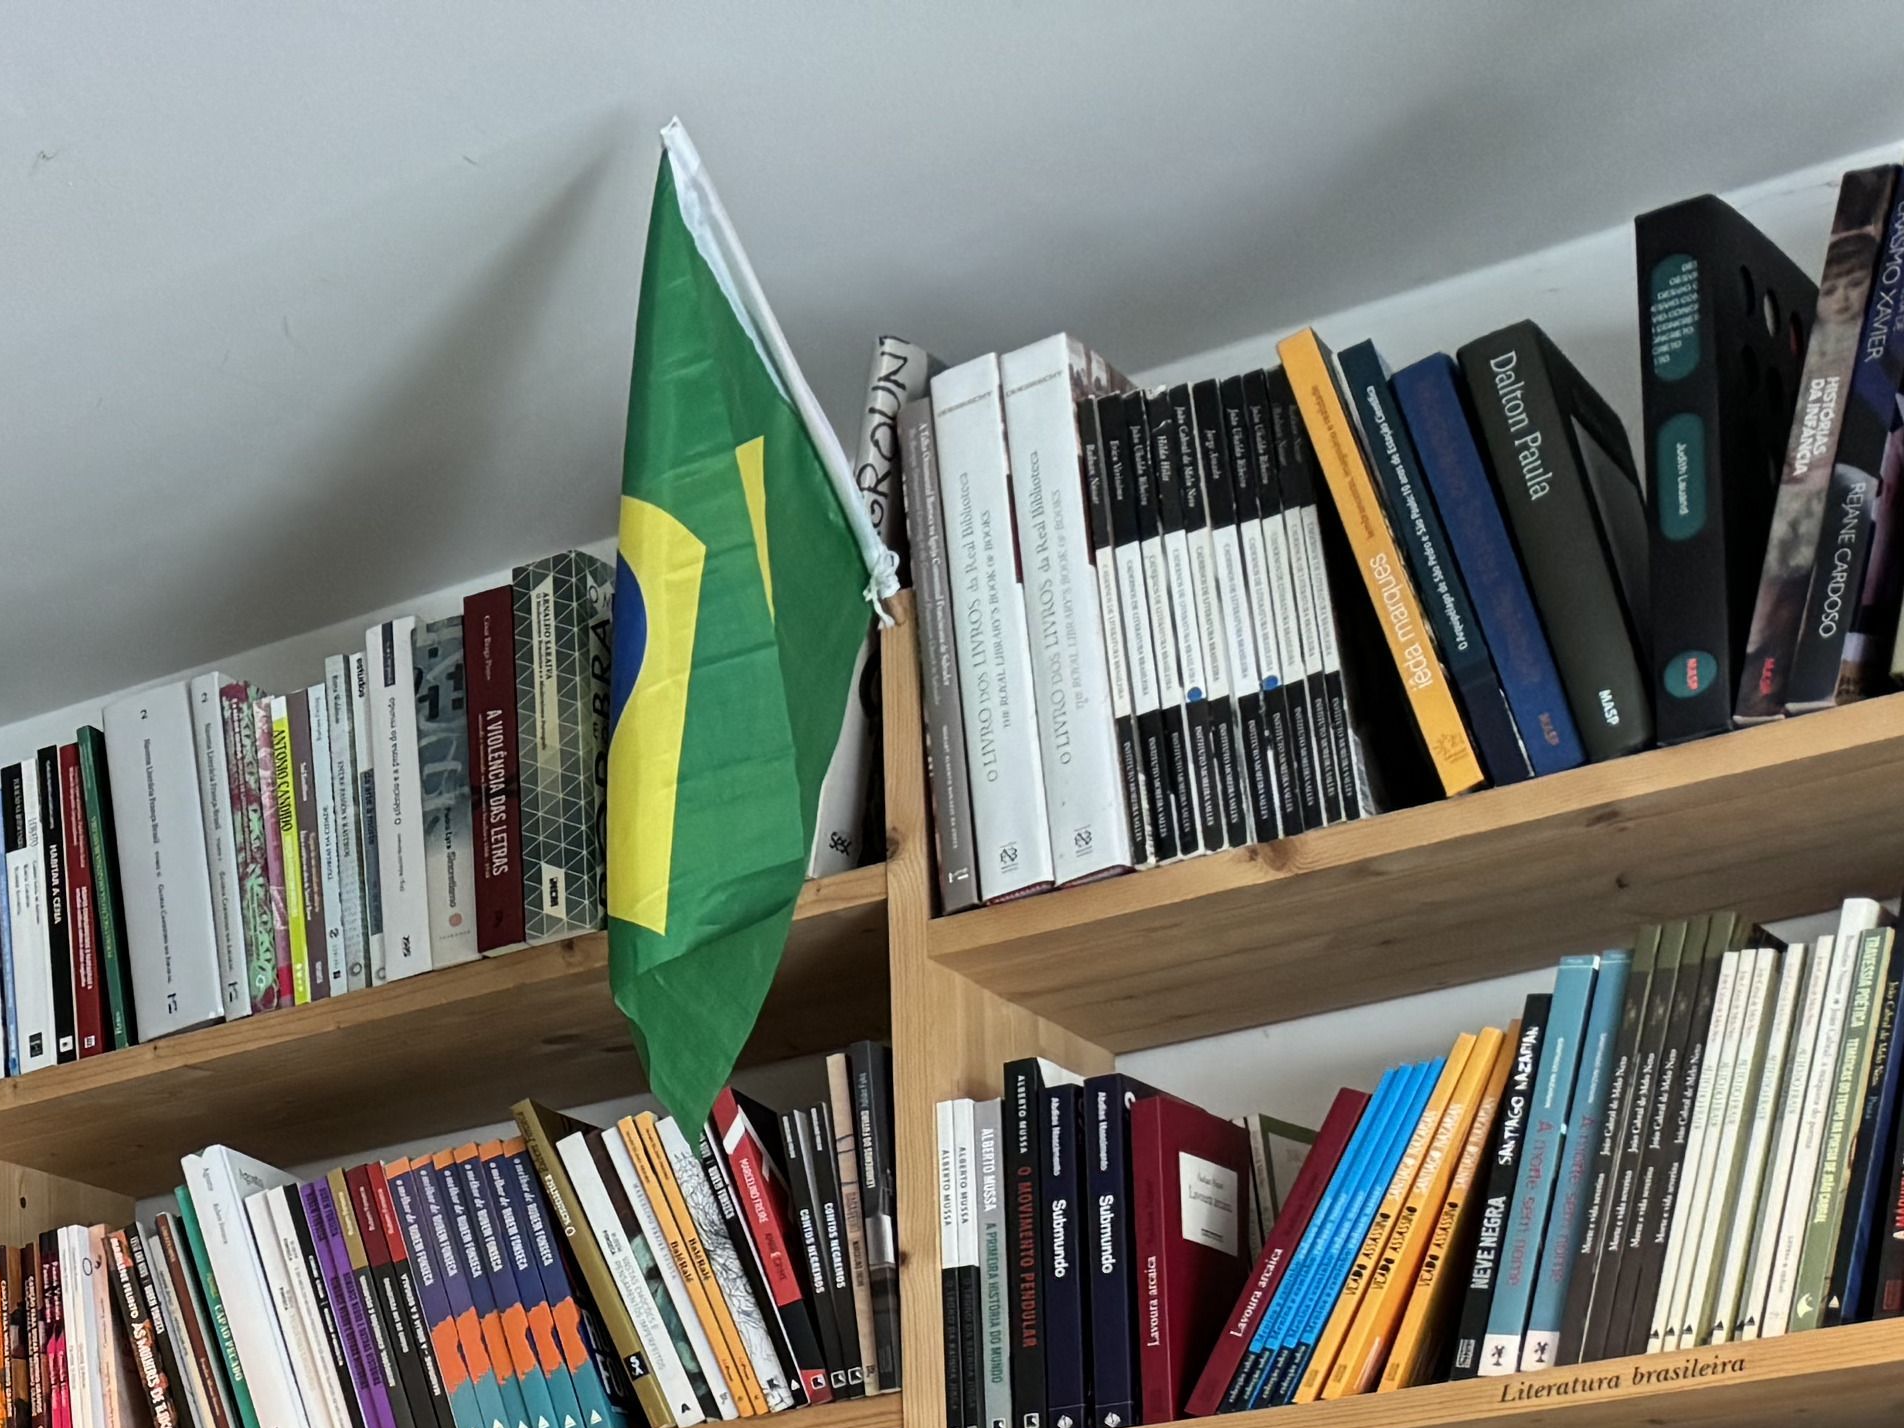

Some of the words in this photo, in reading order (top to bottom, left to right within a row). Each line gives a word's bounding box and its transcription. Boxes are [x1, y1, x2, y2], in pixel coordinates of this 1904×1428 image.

[1490, 349, 1531, 435] Dalton
[1515, 432, 1554, 501] Paula
[1812, 376, 1840, 455] HISTÓRIAS
[1369, 553, 1416, 637] marques
[1818, 548, 1853, 637] CARDOSO
[1598, 689, 1619, 726] MASP
[488, 722, 504, 793] VIOLÊNCIA
[493, 829, 508, 876] LETRAS
[1019, 1121, 1027, 1154] MUSSA
[1018, 1180, 1034, 1266] MOVIMENTO
[1052, 1200, 1069, 1278] Submundo
[1020, 1269, 1037, 1347] PENDULAR
[1144, 1255, 1156, 1296] arcaica
[1147, 1299, 1161, 1347] Lavoura
[1499, 1370, 1624, 1404] Literatura
[1630, 1354, 1747, 1388] brasileira
